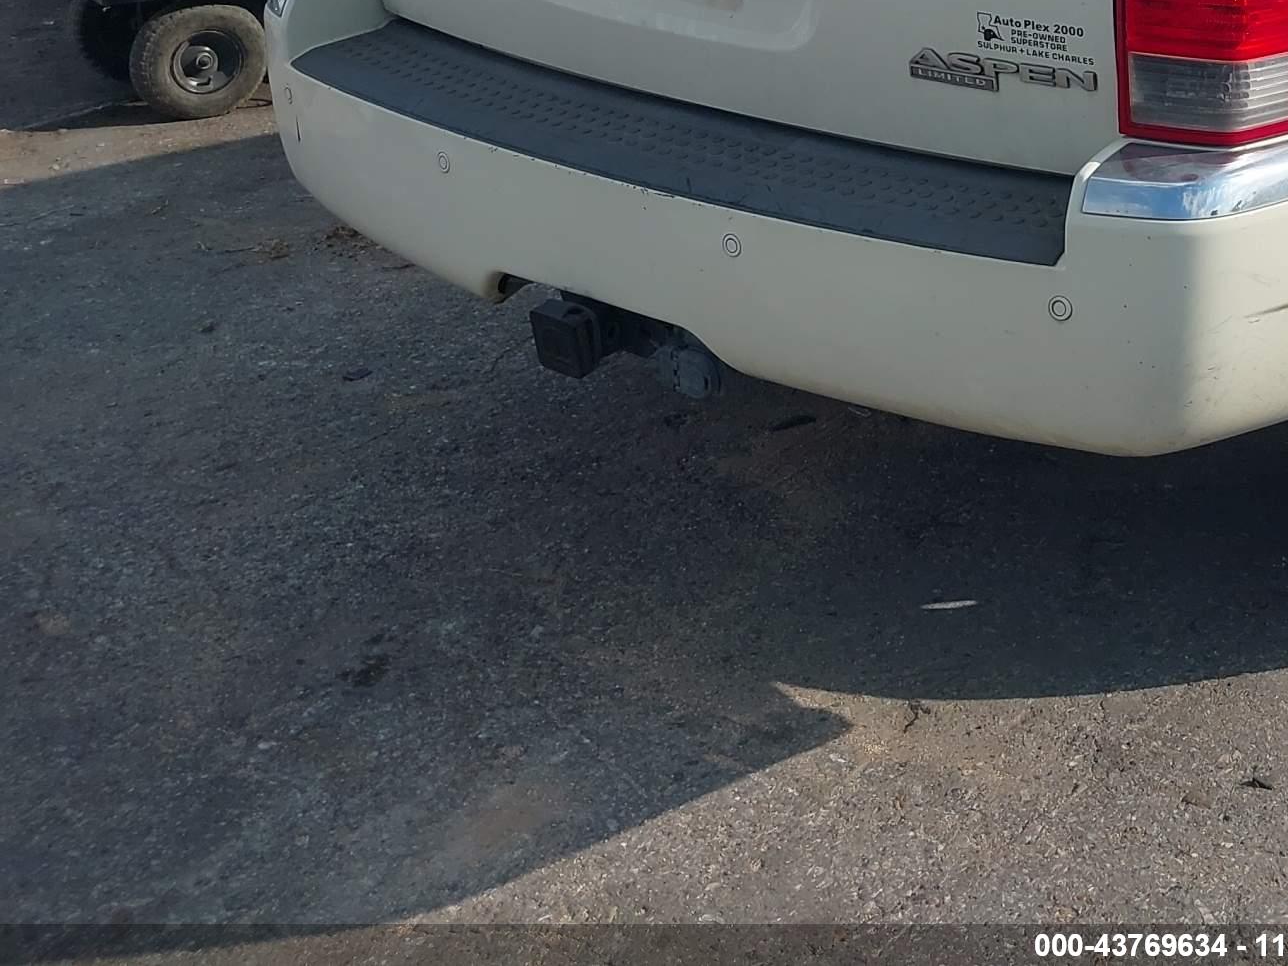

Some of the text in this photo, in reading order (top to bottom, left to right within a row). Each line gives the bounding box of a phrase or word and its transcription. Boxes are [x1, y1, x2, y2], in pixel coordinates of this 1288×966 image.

[994, 15, 1084, 37] Auto Plex 2000
[1011, 29, 1066, 43] PRE-OWNED
[977, 40, 1017, 53] SULPHUR
[1026, 49, 1049, 59] LAKE
[1052, 52, 1095, 66] CHARLES
[1011, 37, 1067, 51] SUPERSTORE
[909, 47, 1098, 92] ASPEN
[917, 67, 987, 87] LIMITED
